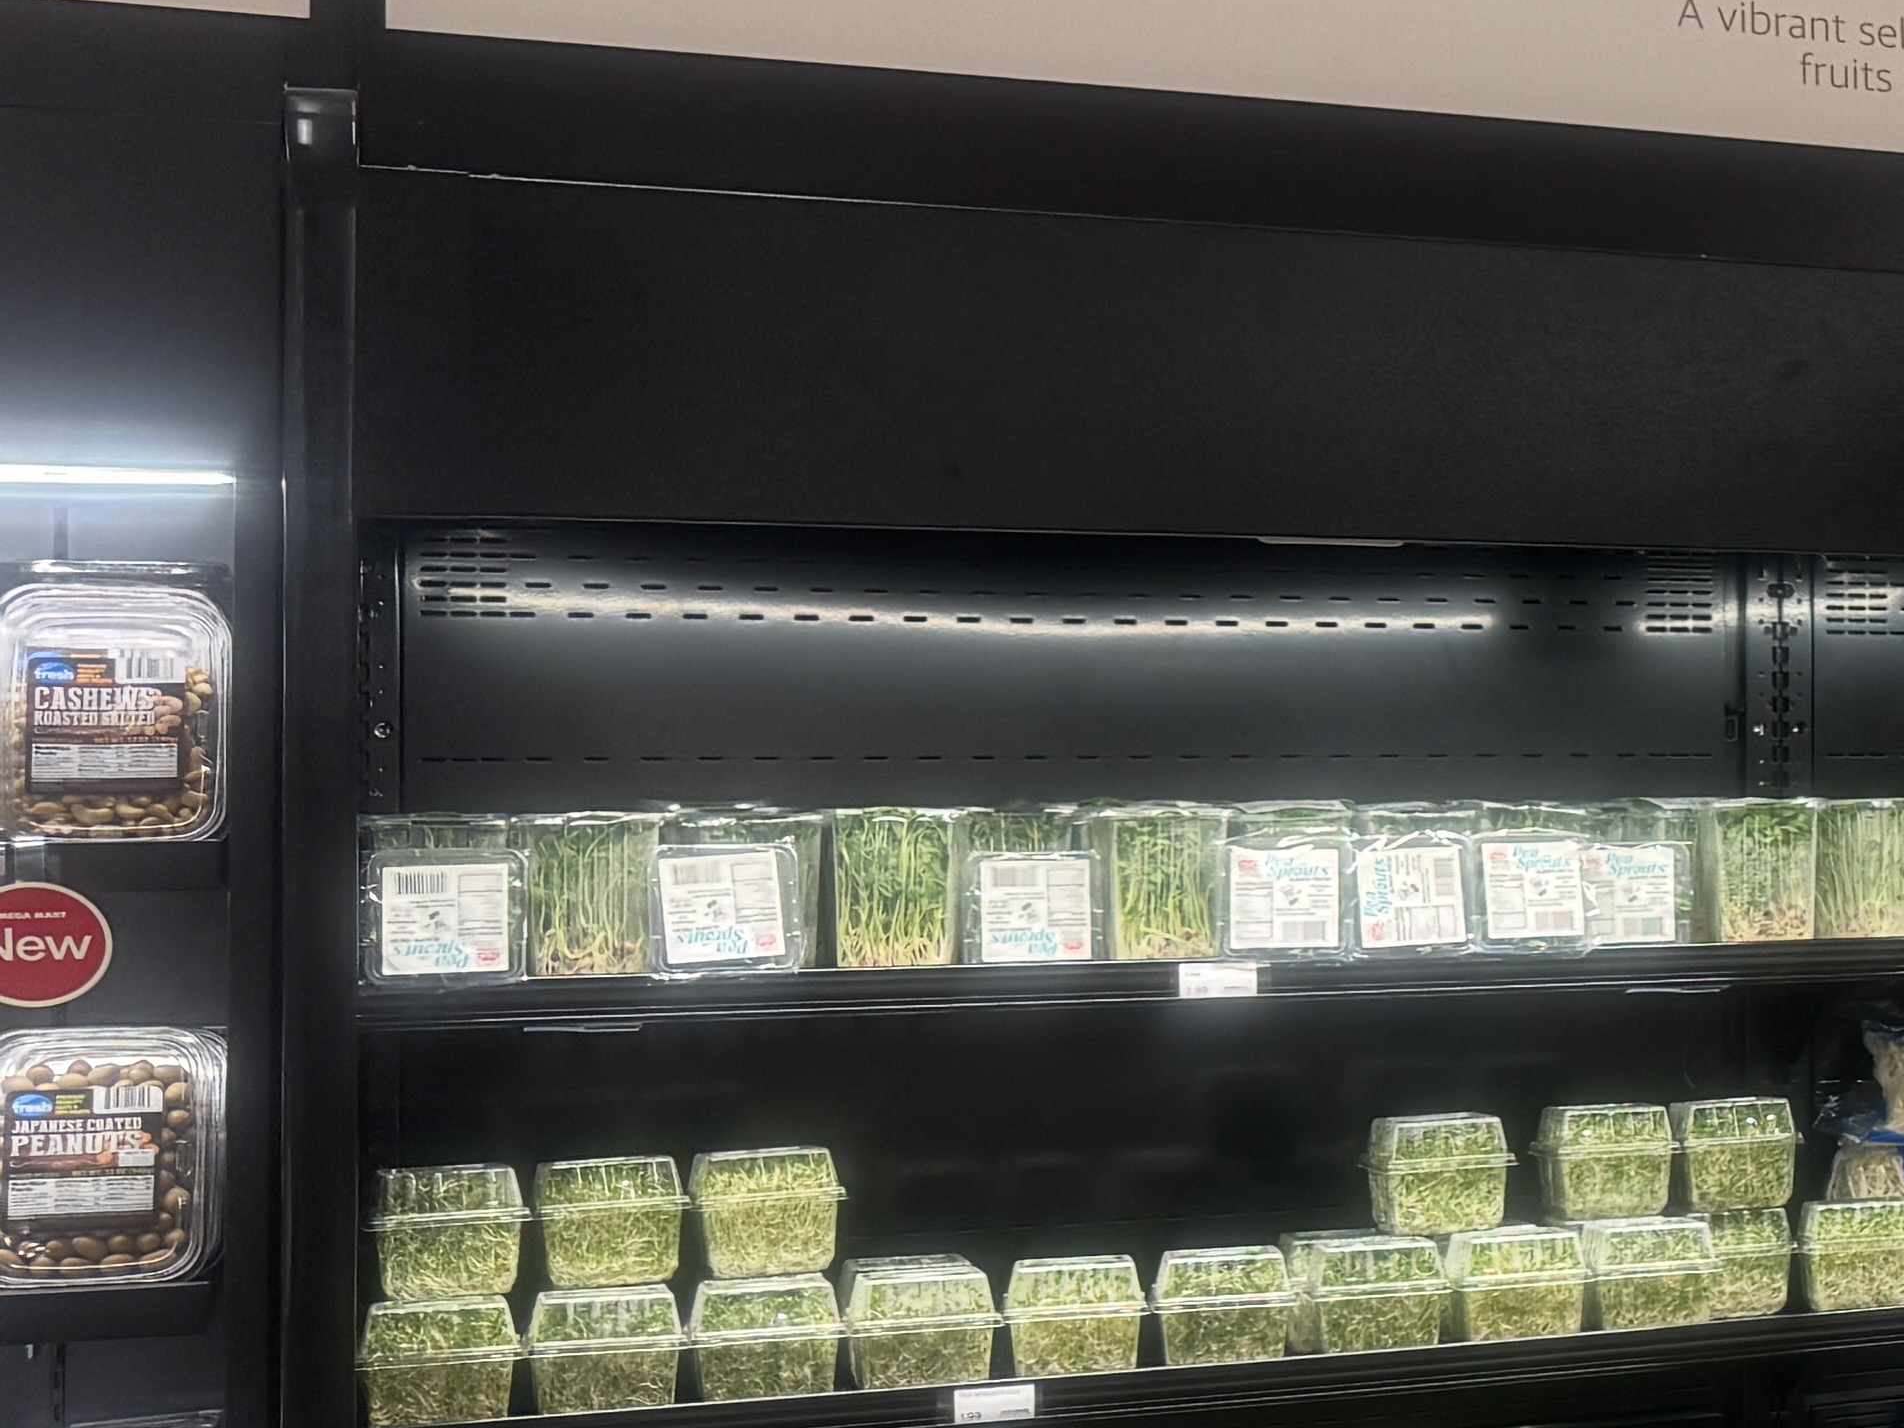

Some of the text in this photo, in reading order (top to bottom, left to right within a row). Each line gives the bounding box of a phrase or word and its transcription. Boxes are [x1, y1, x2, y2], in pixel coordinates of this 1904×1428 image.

[1717, 2, 1846, 44] vibrant
[1800, 54, 1892, 93] fruits
[34, 686, 158, 711] CASHEWS
[34, 710, 155, 726] ROASTED SALTED
[11, 1117, 141, 1134] JAPANESE COATED
[11, 1131, 143, 1157] PEANUTS
